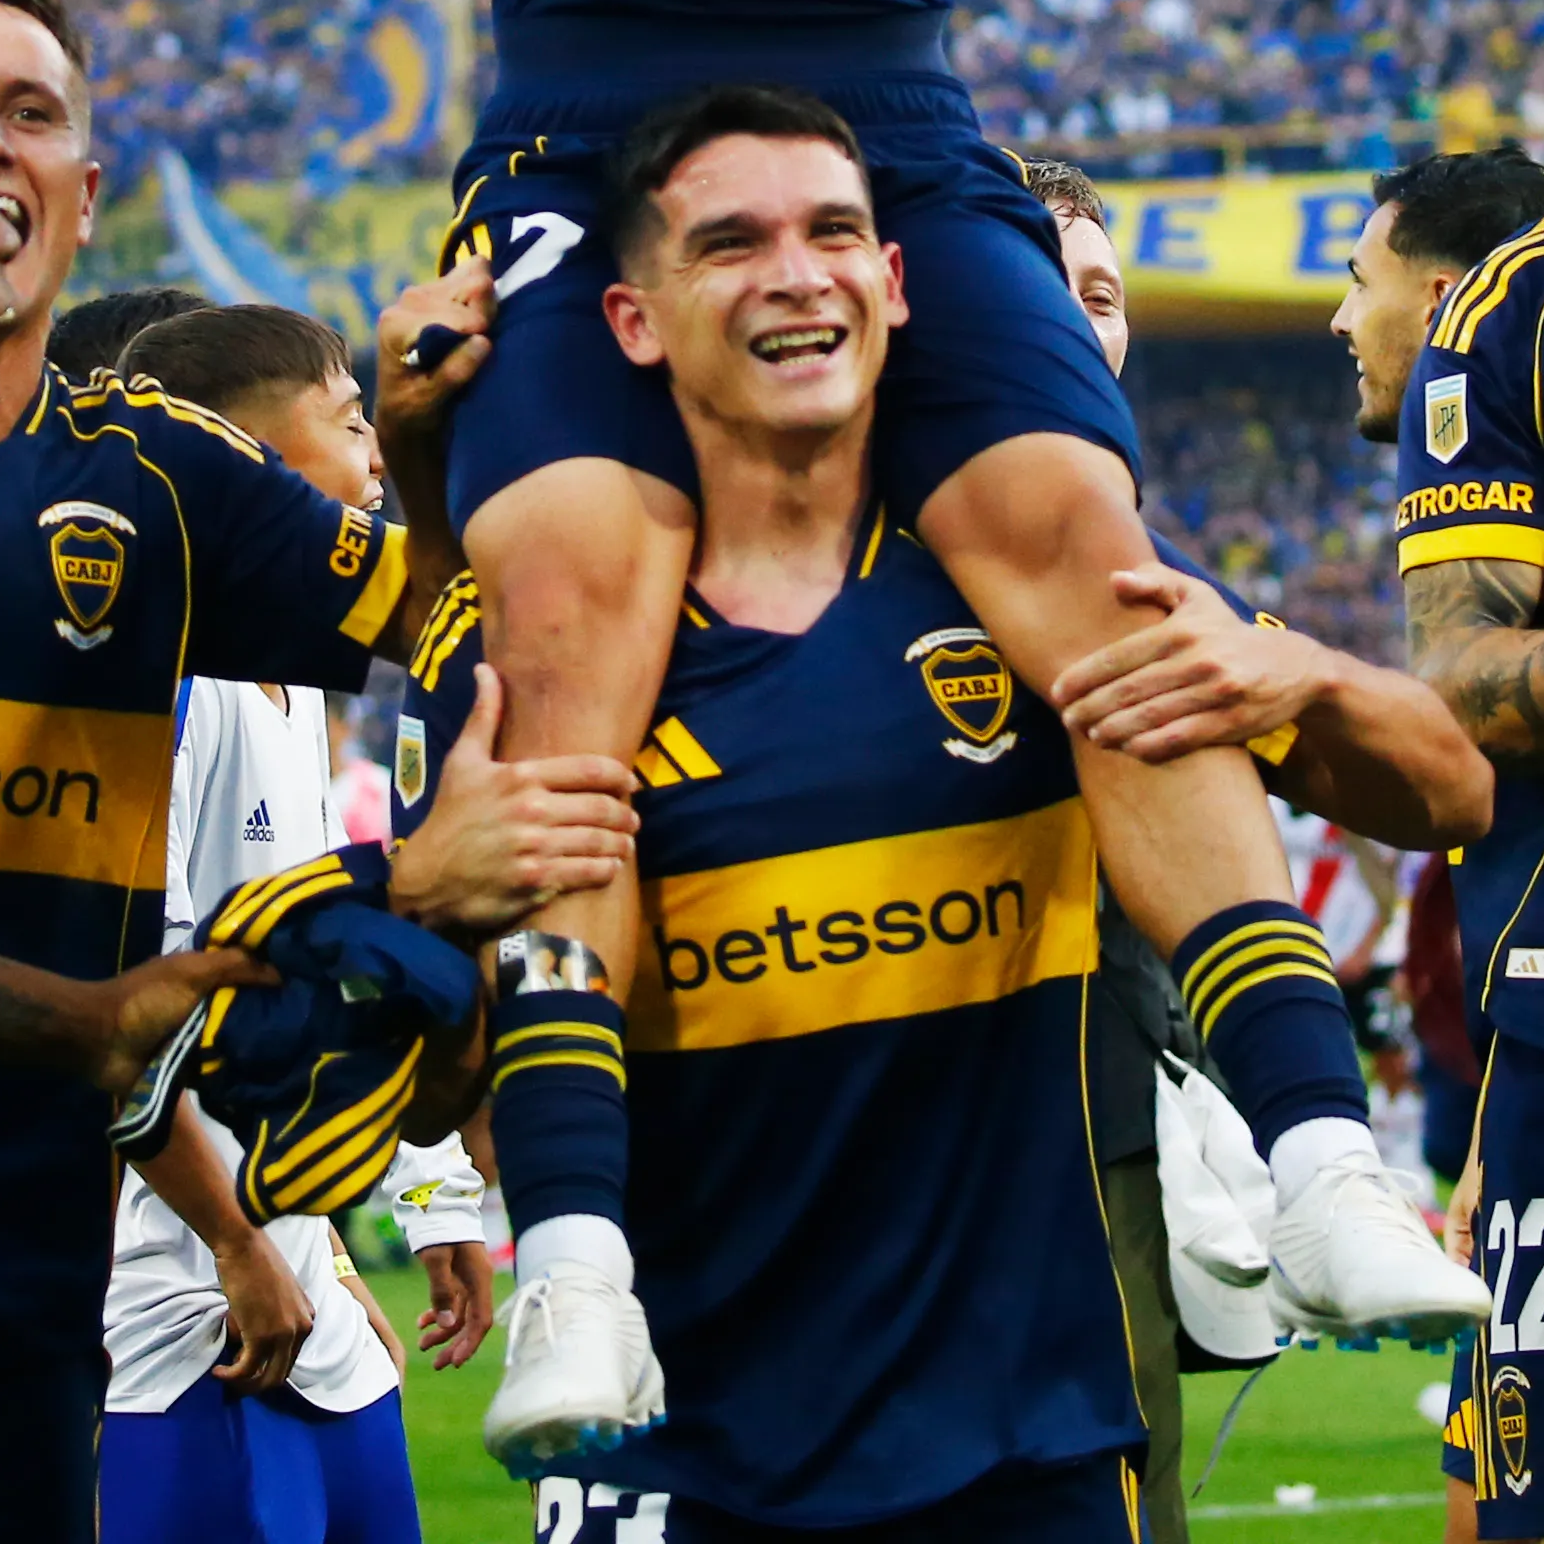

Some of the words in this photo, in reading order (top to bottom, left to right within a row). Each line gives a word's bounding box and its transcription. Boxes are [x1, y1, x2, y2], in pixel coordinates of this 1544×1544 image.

[65, 559, 112, 581] CABJ
[941, 678, 999, 699] CABJ
[653, 878, 1026, 992] betsson
